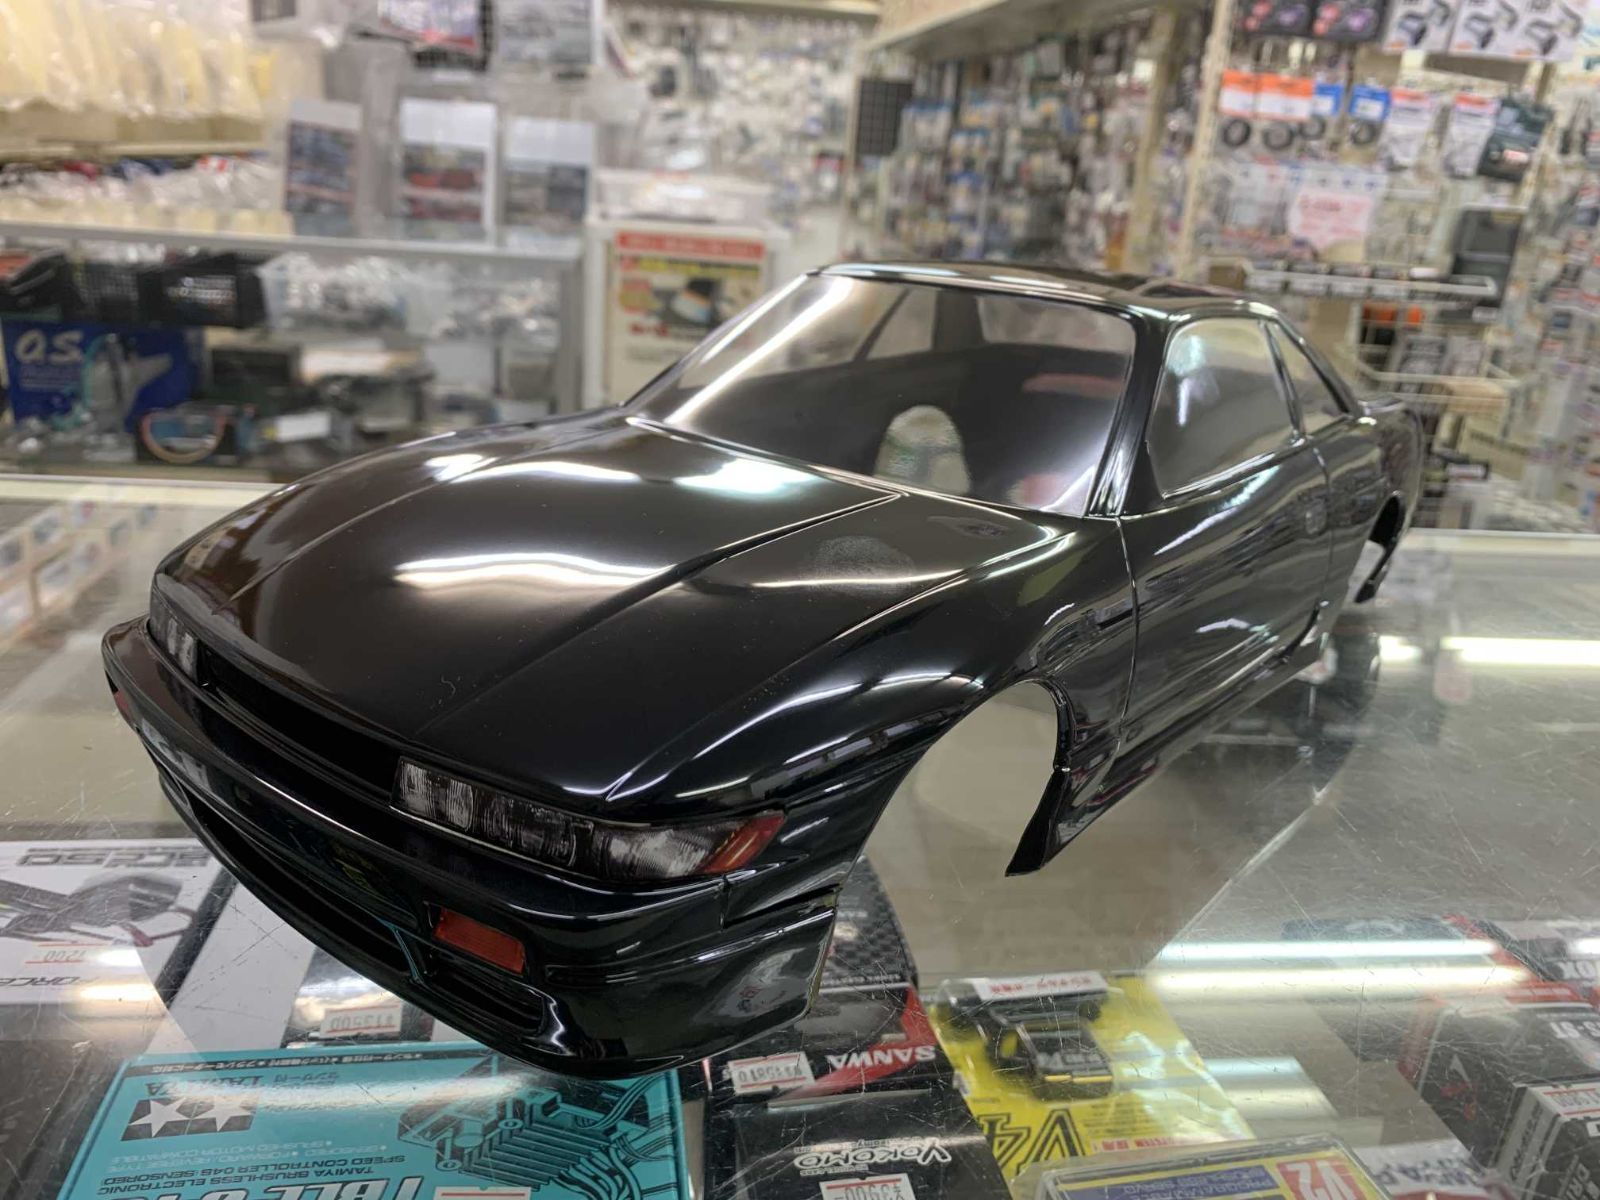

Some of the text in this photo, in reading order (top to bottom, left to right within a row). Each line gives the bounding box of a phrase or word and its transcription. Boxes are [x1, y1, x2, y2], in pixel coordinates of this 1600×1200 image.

[825, 1045, 935, 1070] SANWA
[978, 1109, 1086, 1177] V4
[351, 1155, 406, 1167] SPEED
[793, 1138, 952, 1169] YOKOMO
[237, 1158, 348, 1174] CONTROLLER
[313, 1166, 374, 1178] TAMIYA
[209, 1171, 310, 1185] BRUSHLESS
[96, 1178, 207, 1196] ELECTRONIC
